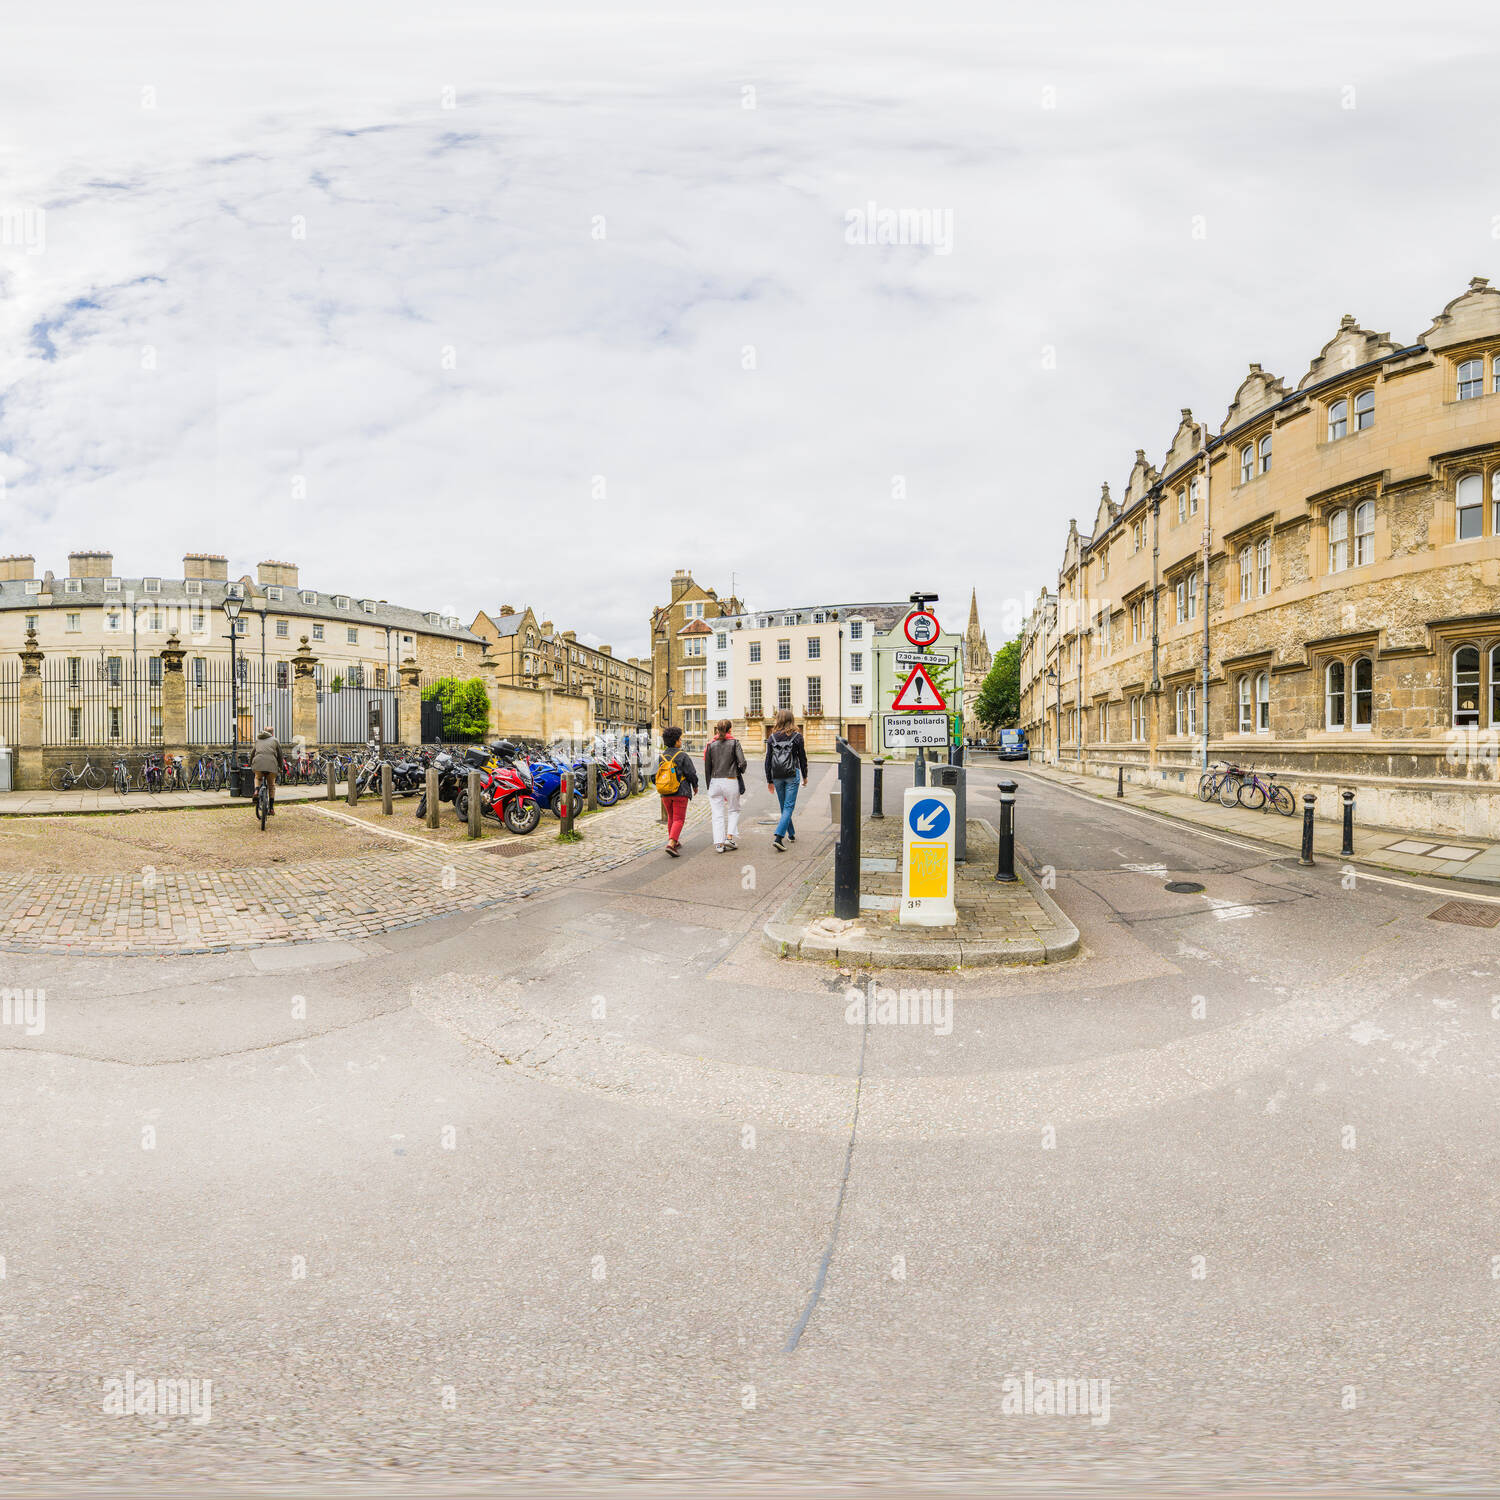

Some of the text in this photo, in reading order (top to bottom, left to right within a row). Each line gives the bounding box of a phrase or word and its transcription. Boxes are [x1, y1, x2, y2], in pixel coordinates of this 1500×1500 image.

[887, 718, 911, 726] Rising
[888, 728, 905, 736] 7.30
[914, 736, 933, 744] 6.30
